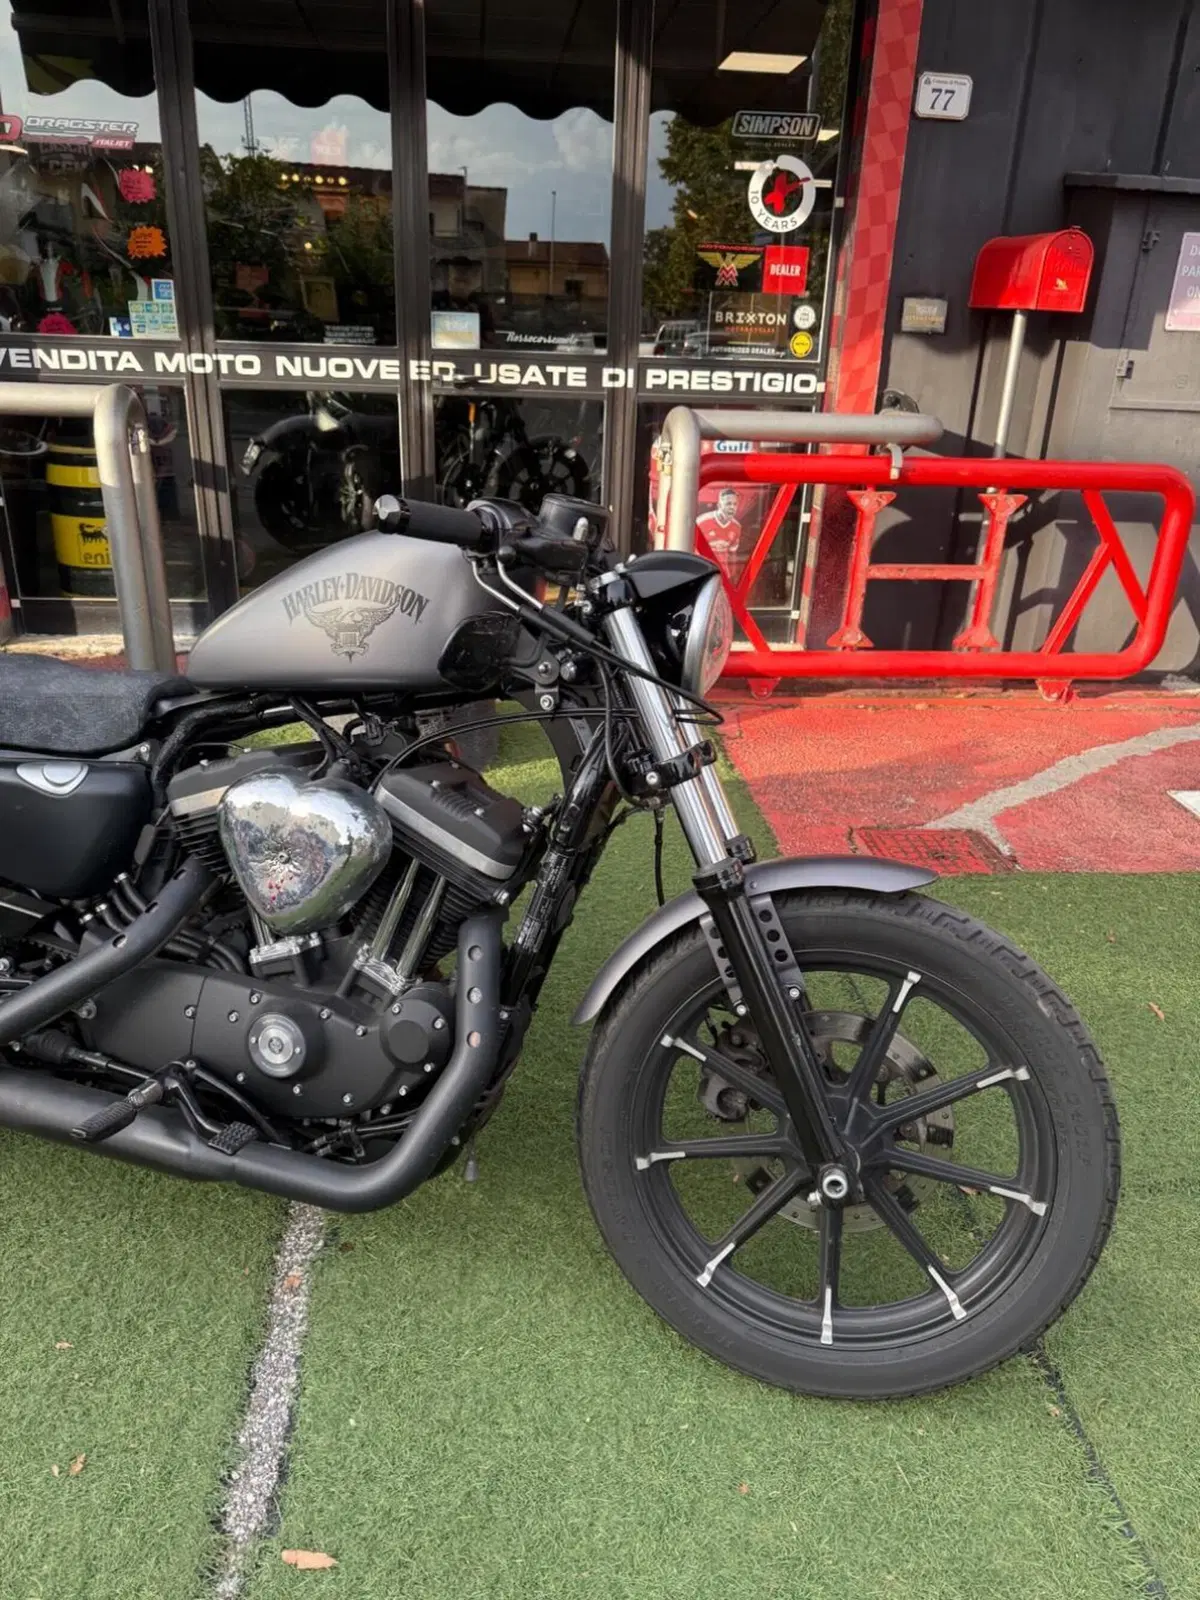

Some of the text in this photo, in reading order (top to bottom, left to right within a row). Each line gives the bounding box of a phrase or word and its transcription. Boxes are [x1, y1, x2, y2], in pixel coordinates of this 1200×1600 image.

[930, 88, 956, 111] 77
[26, 117, 138, 132] DRAGSTER
[739, 114, 814, 136] SIMPSON
[750, 190, 798, 230] 10 YEARS
[769, 263, 801, 277] DEALER
[714, 311, 787, 326] BRIXTON
[155, 351, 261, 375] MOTO
[275, 355, 401, 380] NUOVE
[409, 359, 456, 382] ED
[474, 362, 588, 388] USATE
[602, 367, 634, 389] DI
[716, 440, 750, 452] Gulf
[83, 548, 110, 565] eni
